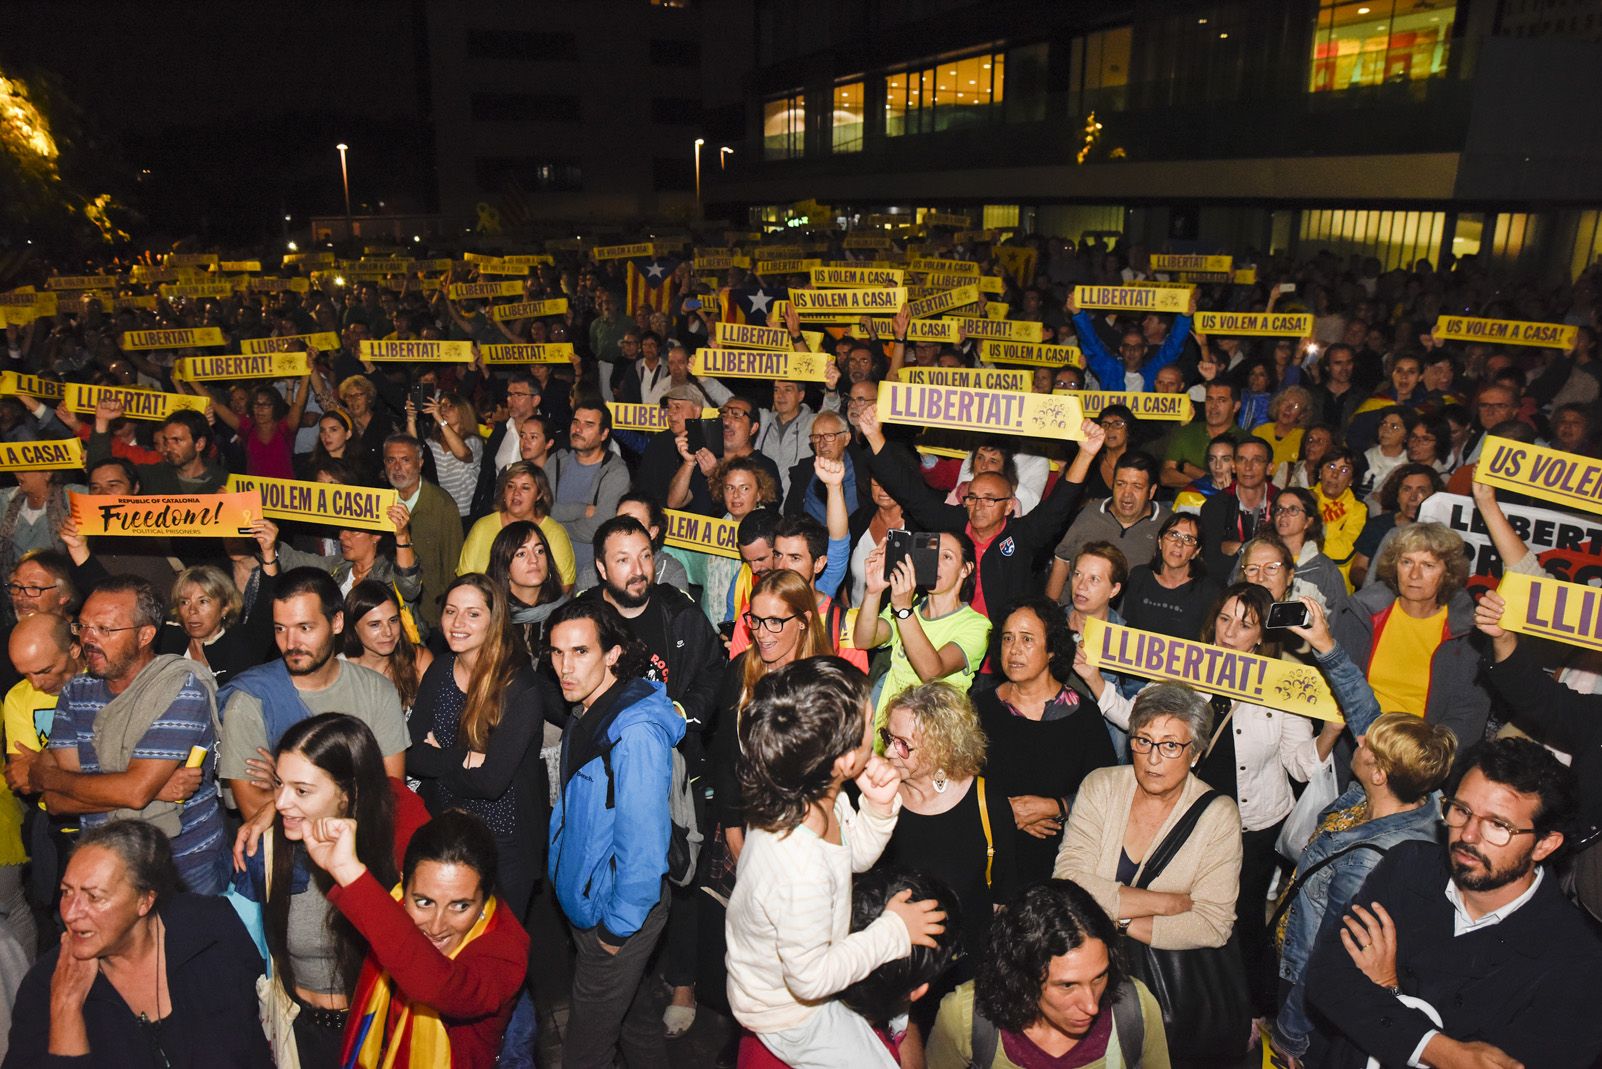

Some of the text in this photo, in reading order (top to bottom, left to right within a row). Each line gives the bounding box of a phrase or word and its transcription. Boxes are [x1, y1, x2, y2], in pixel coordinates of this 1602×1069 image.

[761, 259, 804, 272] LLIBERTAT!
[954, 263, 975, 273] CASA!
[1157, 256, 1207, 269] LLIBERTAT!
[814, 269, 895, 283] US VOLEM A CASA!
[931, 273, 981, 288] LLIBERTAT!
[455, 283, 502, 297] LLIBERTAT!
[793, 293, 808, 307] US
[809, 292, 848, 307] VOLEM
[851, 292, 860, 306] A
[862, 291, 897, 306] CASA!
[1081, 287, 1156, 307] LLIBERTAT!
[498, 301, 546, 318] LLIBERTAT!
[909, 291, 955, 317] IBERTAT!
[874, 320, 893, 334] VOL
[911, 322, 918, 336] A
[920, 323, 951, 337] CASA!
[1202, 315, 1307, 331] US VOLEM A CASA!
[1446, 319, 1564, 342] US VOLEM A CASA!
[130, 329, 196, 347] LLIBERTAT!
[722, 324, 790, 348] LLIBERTAT!
[370, 342, 441, 359] LLIBERTAT!
[489, 344, 547, 362] LLIBERTAT!
[989, 343, 1075, 364] US VOLEM A CASA!
[192, 355, 273, 377] LLIBERTAT!
[703, 350, 789, 375] LLIBERTAT!
[16, 374, 66, 398] LLIBE
[909, 370, 1024, 391] US VOLEM A CASA!
[890, 385, 1025, 428] LLIBERTAT!
[1083, 394, 1182, 413] VOLEM A CASA!
[614, 404, 669, 427] LLIBER
[6, 447, 20, 465] A
[21, 444, 72, 464] CASA!
[1489, 445, 1527, 478] US
[259, 482, 312, 512] VOLEM
[317, 489, 327, 513] A
[333, 490, 381, 519] CASA!
[98, 501, 224, 531] Freedom!
[701, 522, 712, 544] A
[1101, 626, 1268, 695] LLIBERTAT!
